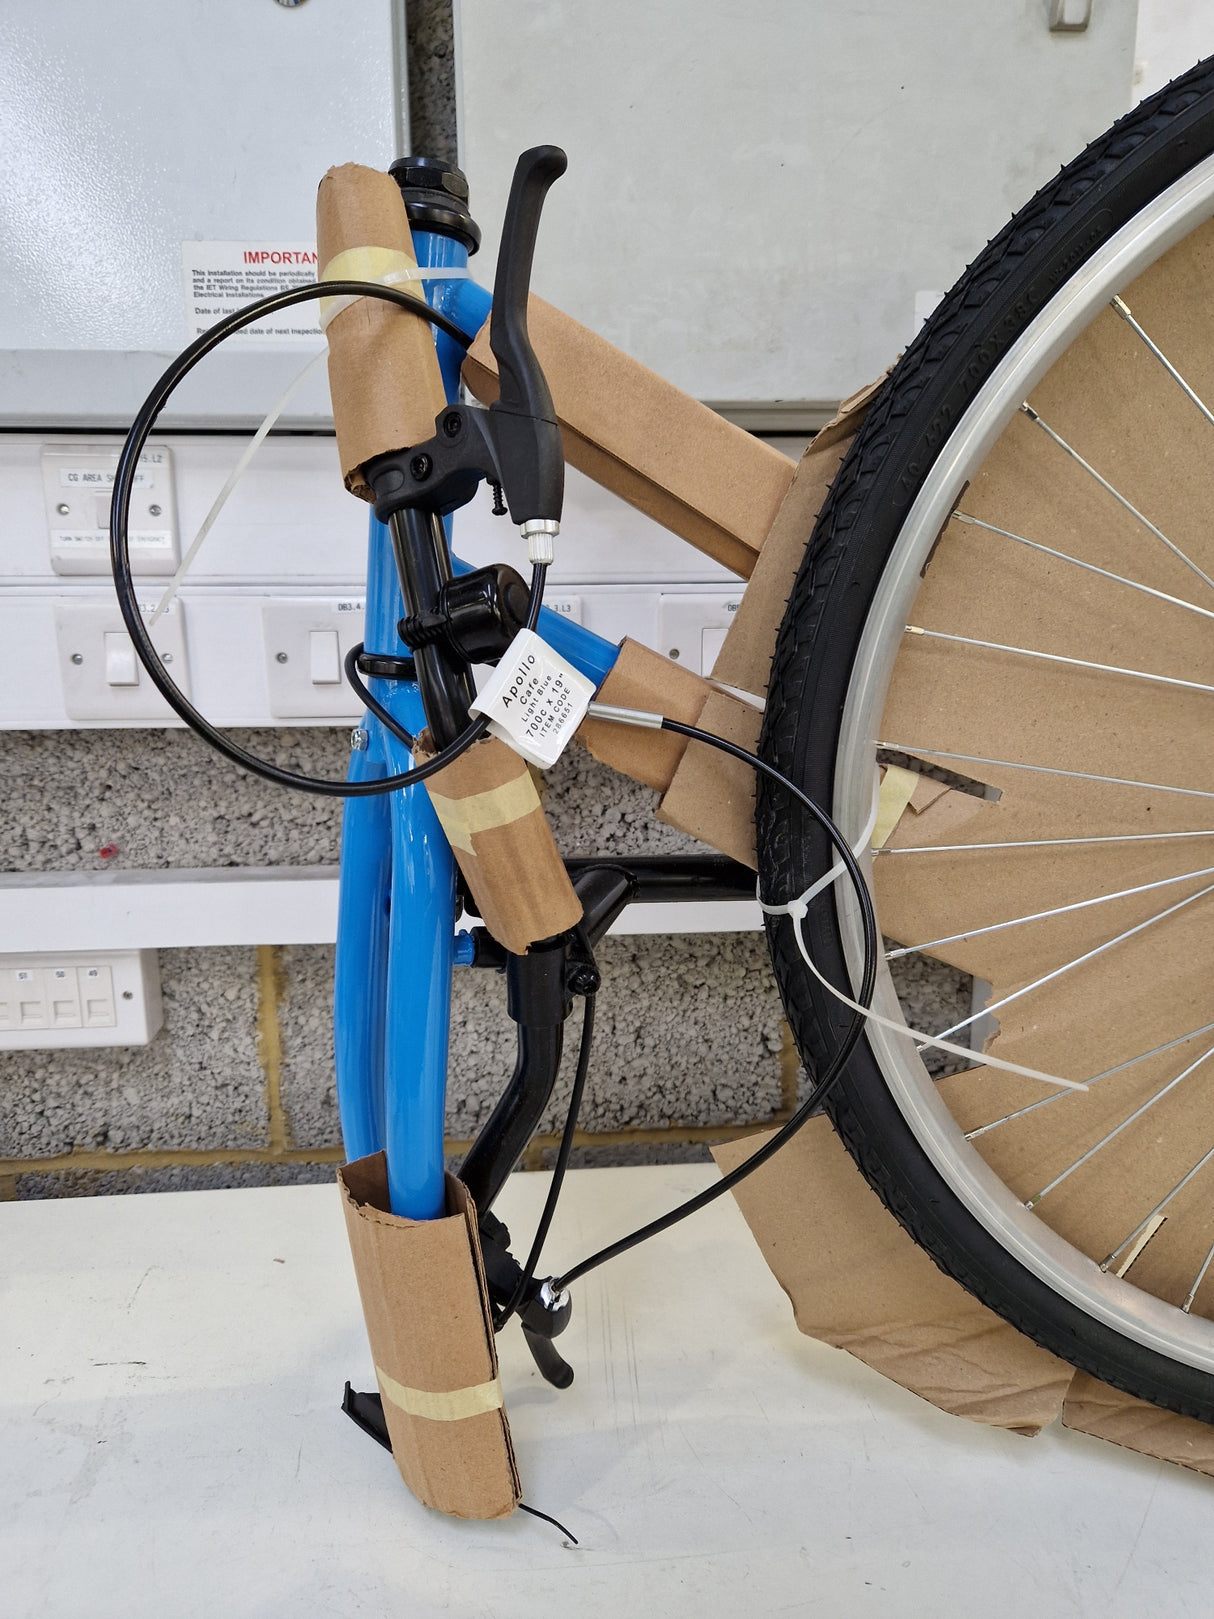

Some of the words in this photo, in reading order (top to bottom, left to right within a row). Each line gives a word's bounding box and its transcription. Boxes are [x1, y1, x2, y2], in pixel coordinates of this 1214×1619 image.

[243, 251, 318, 264] IMPORTAN
[279, 270, 316, 278] periodically
[214, 277, 233, 285] report
[218, 284, 239, 292] Wiring
[241, 284, 278, 292] Regulations
[195, 307, 211, 315] Date
[213, 307, 221, 315] of
[82, 473, 103, 482] AREA
[337, 603, 365, 611] DB3.4.
[502, 655, 535, 708] Apollo
[520, 678, 539, 705] Cafe
[522, 698, 538, 722] Light
[537, 676, 551, 696] Blue
[525, 708, 547, 738] 700c
[551, 672, 564, 695] 19"
[540, 715, 554, 737] ITEM
[553, 687, 571, 713] CODE
[552, 702, 573, 735] 286651
